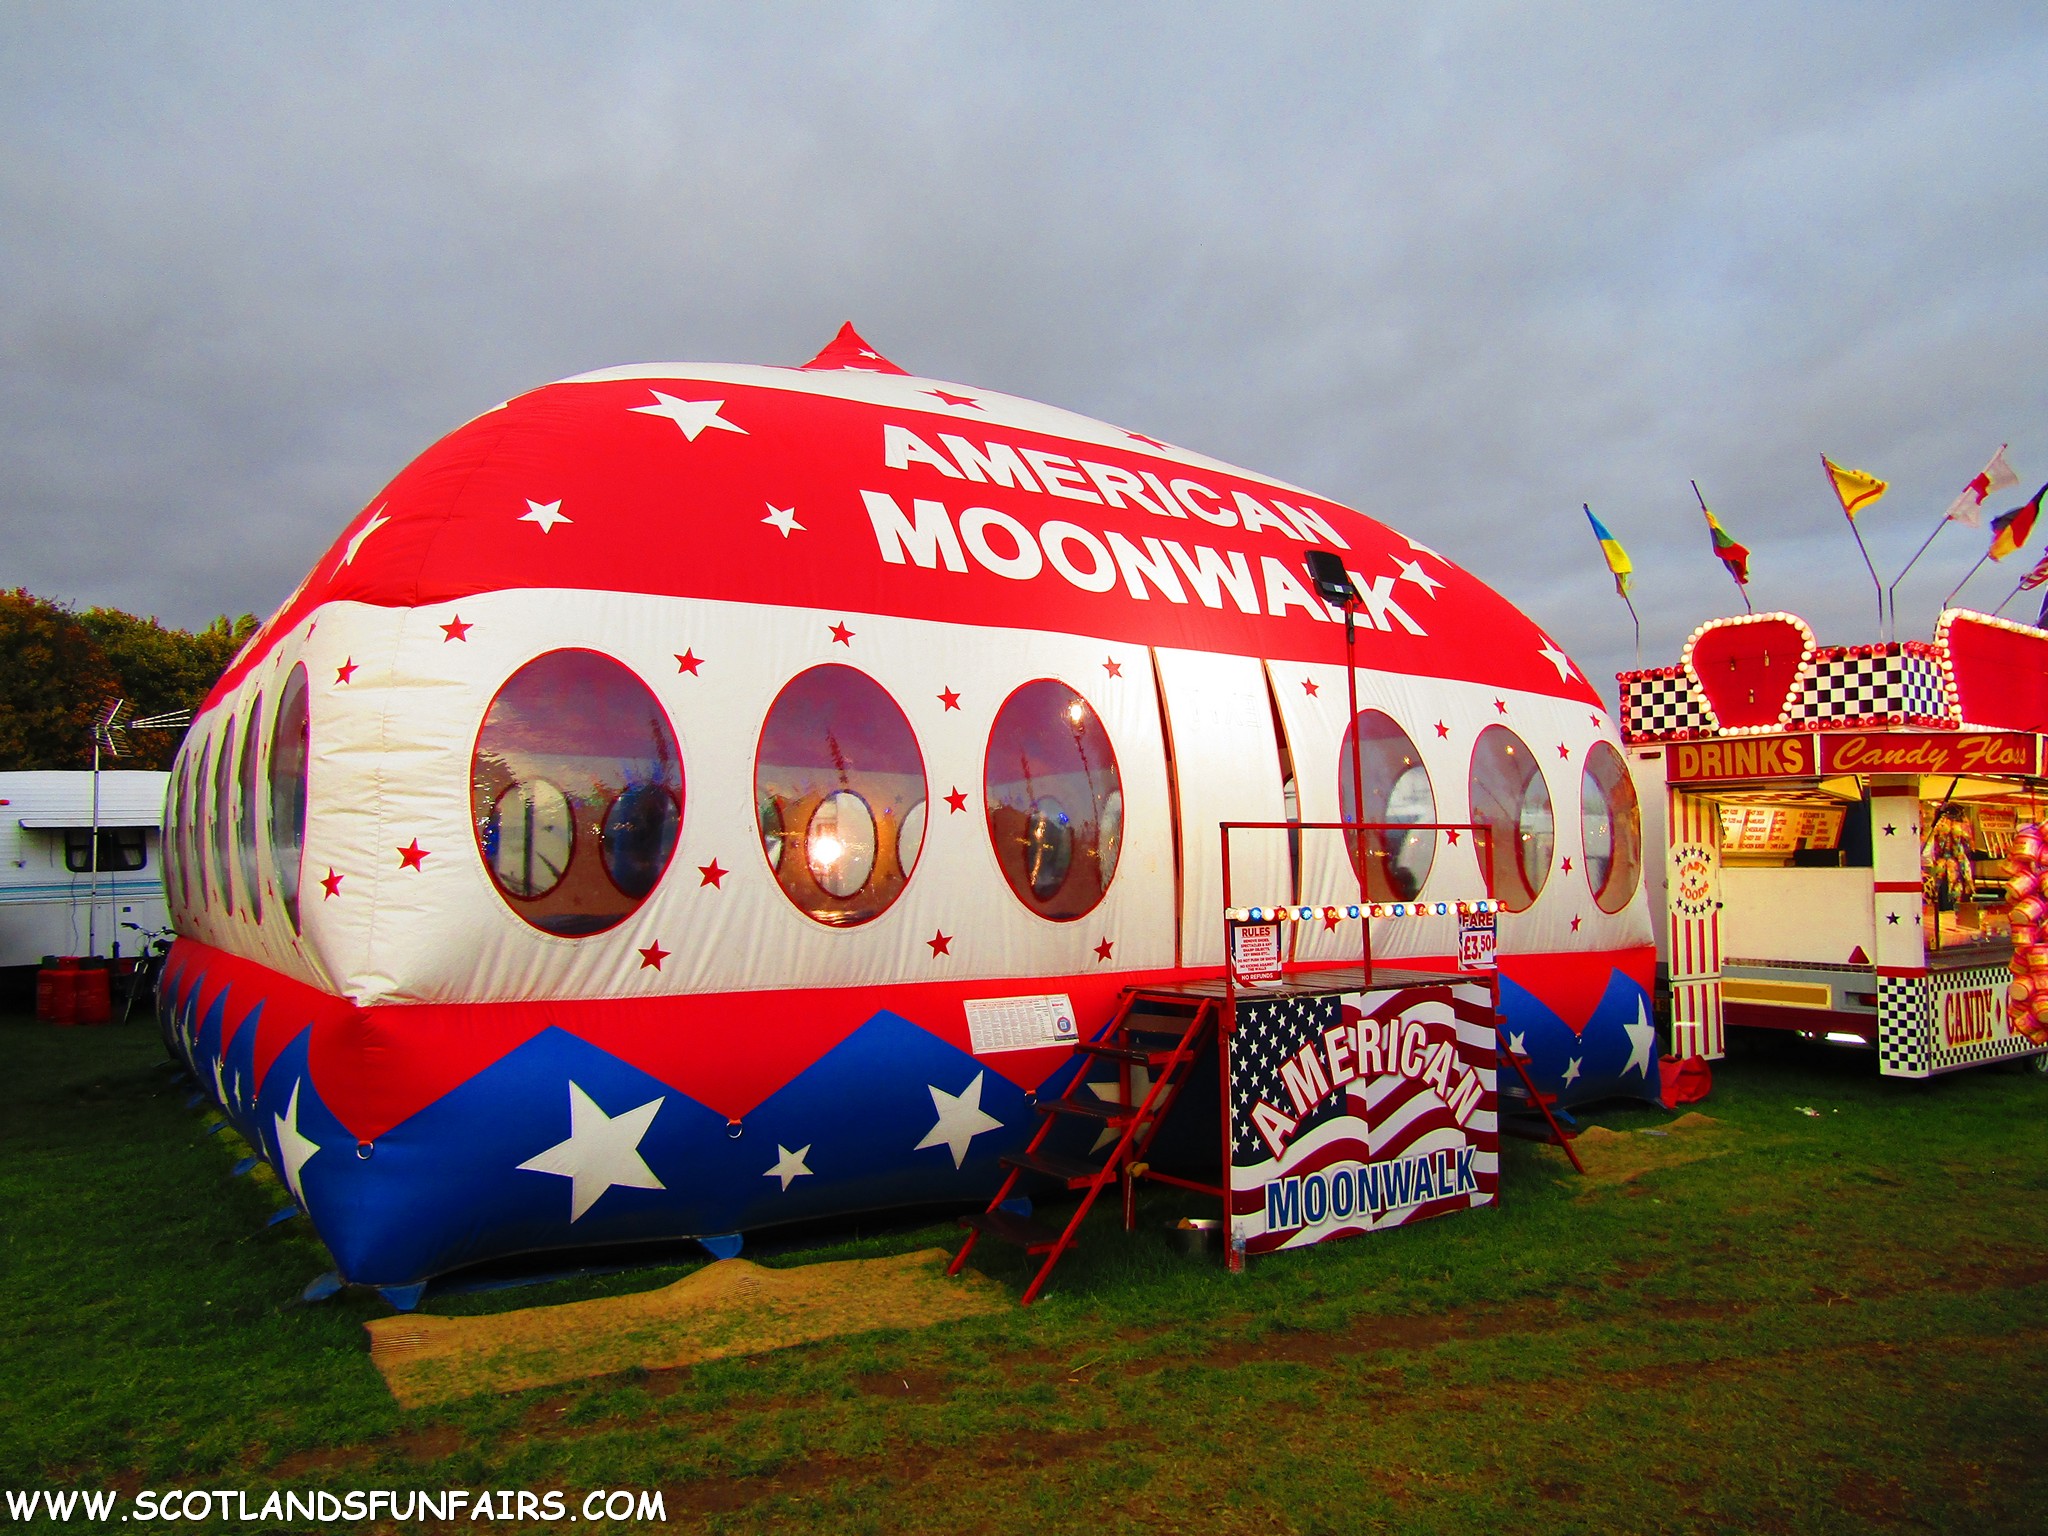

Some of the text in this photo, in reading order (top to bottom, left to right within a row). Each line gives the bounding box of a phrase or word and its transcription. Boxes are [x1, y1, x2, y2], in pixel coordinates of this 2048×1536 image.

[883, 424, 1352, 550] AMERICAN
[1678, 738, 1804, 778] DRINKS
[1832, 734, 2027, 773] Candy Floss
[1680, 861, 1708, 878] FAST
[1241, 926, 1271, 938] RULES
[1462, 912, 1493, 927] FARE
[1464, 934, 1492, 960] £3.50
[1945, 987, 1993, 1047] CANDY
[1252, 1018, 1485, 1160] AMERICAN
[1265, 1145, 1479, 1233] MOONWALK
